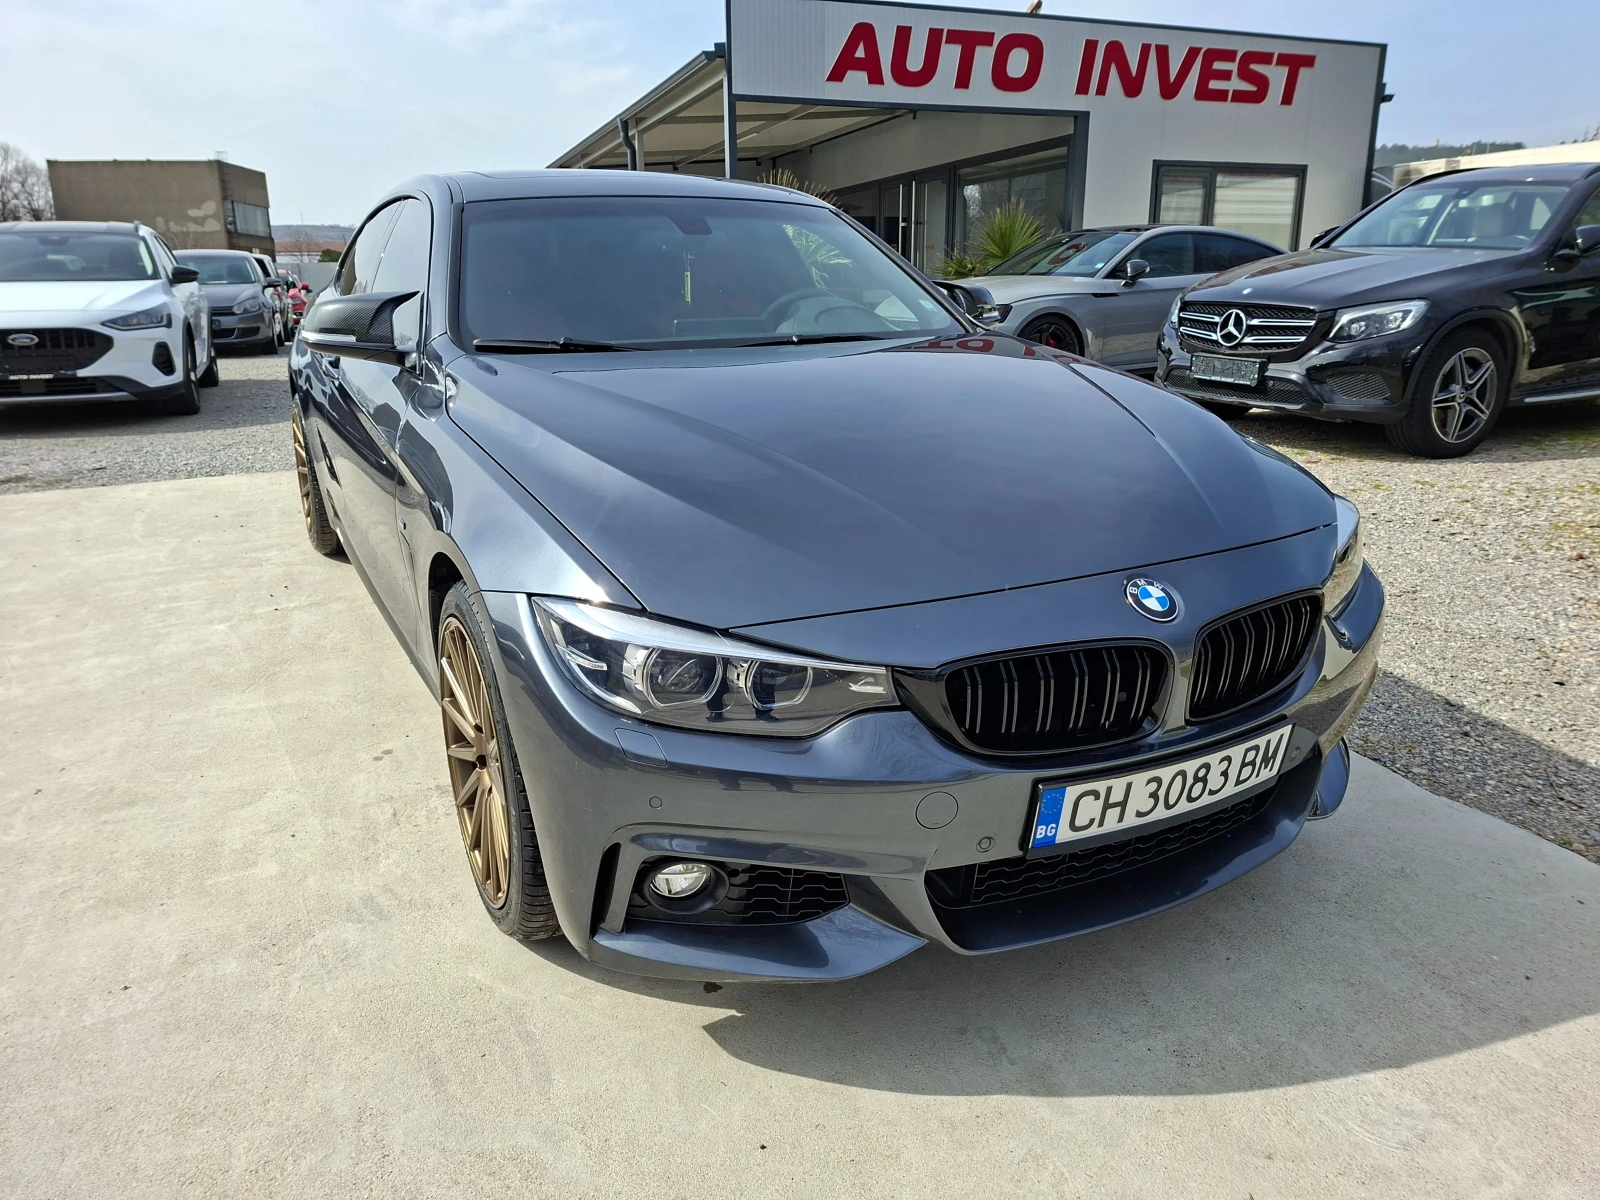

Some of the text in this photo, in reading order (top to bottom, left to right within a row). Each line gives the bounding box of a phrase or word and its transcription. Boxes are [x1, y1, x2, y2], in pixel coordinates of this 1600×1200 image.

[826, 21, 1316, 106] AUTO INVEST
[1129, 579, 1163, 594] BMW
[1135, 754, 1233, 818] 3083
[1233, 733, 1285, 788] BM
[1036, 823, 1057, 839] BG
